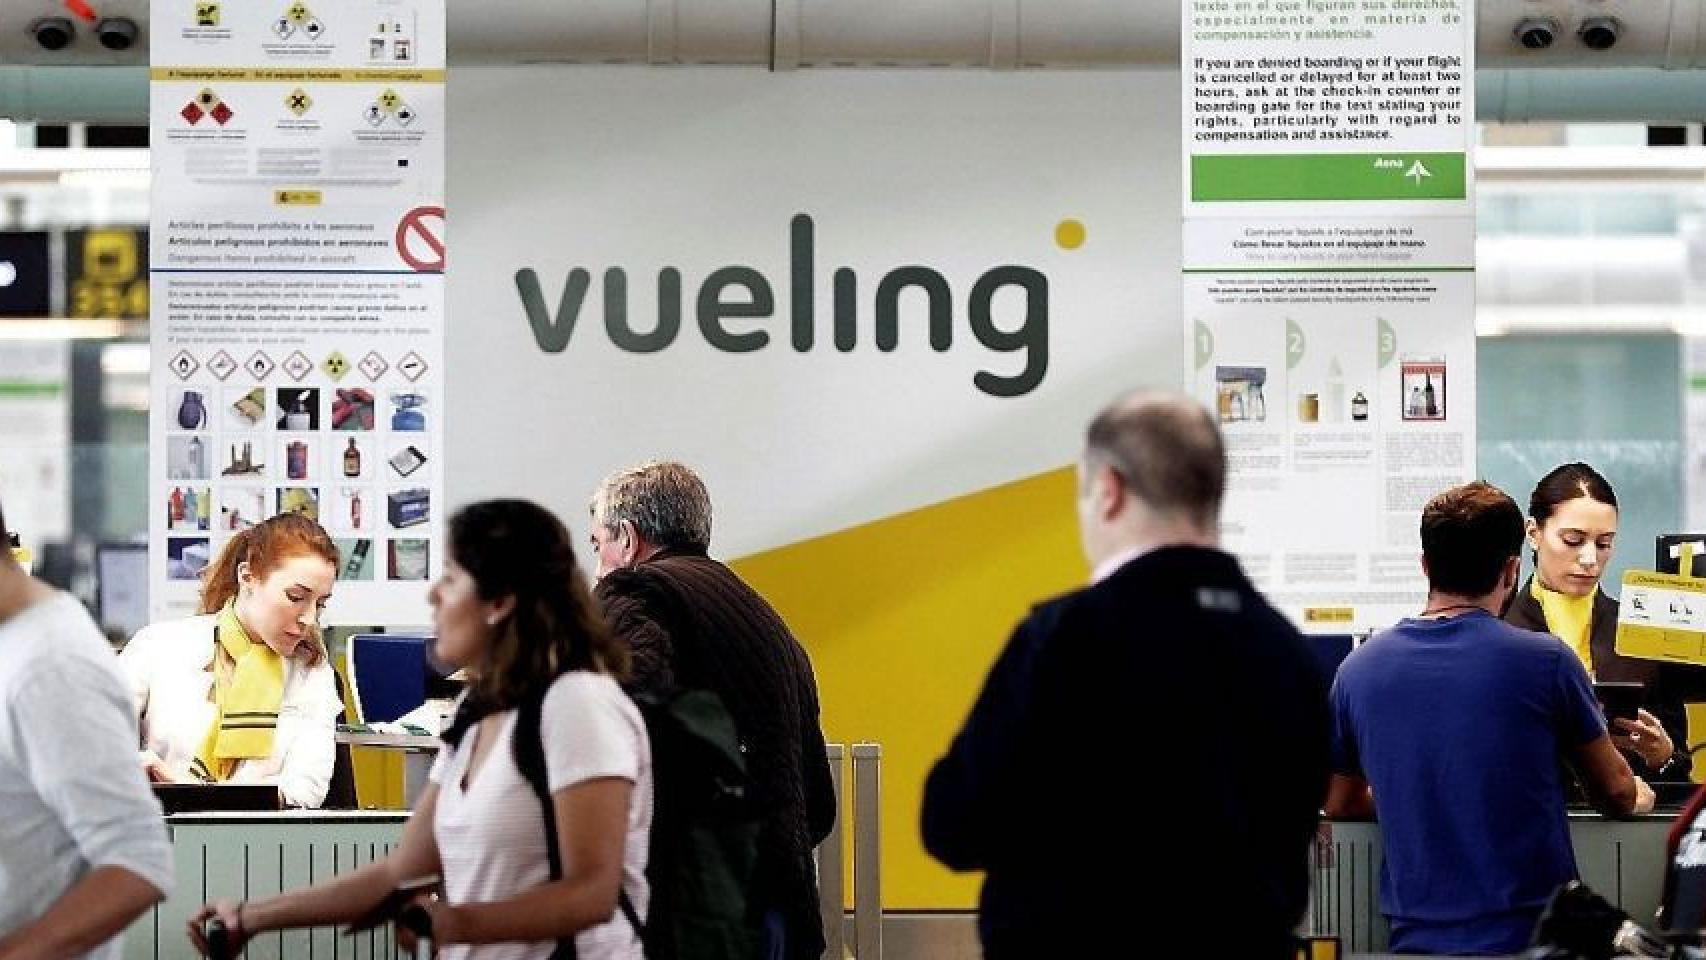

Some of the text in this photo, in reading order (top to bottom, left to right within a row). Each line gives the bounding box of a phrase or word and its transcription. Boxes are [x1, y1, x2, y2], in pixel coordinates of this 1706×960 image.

[1235, 0, 1249, 11] en
[1257, 0, 1268, 11] el
[1276, 0, 1301, 13] que
[1306, 0, 1353, 13] figuran
[1362, 0, 1386, 11] sus
[1195, 14, 1461, 27] especialmente en materia de
[1294, 31, 1302, 42] y
[1195, 57, 1461, 71] If you are denied boarding or if your flight
[1195, 72, 1461, 86] is cancelled or delayed for at least two
[1195, 86, 1461, 99] hours, ask at the check-in counter or
[1195, 100, 1461, 114] boarding gate for the text stating your
[1253, 115, 1338, 128] particularly
[1348, 115, 1379, 127] with
[1389, 115, 1437, 128] regard
[1447, 115, 1461, 127] to
[1195, 129, 1392, 142] compensation and assistance.
[515, 213, 1049, 398] vueling
[1199, 335, 1209, 352] 1
[1289, 335, 1300, 352] 2
[1381, 335, 1393, 352] 3
